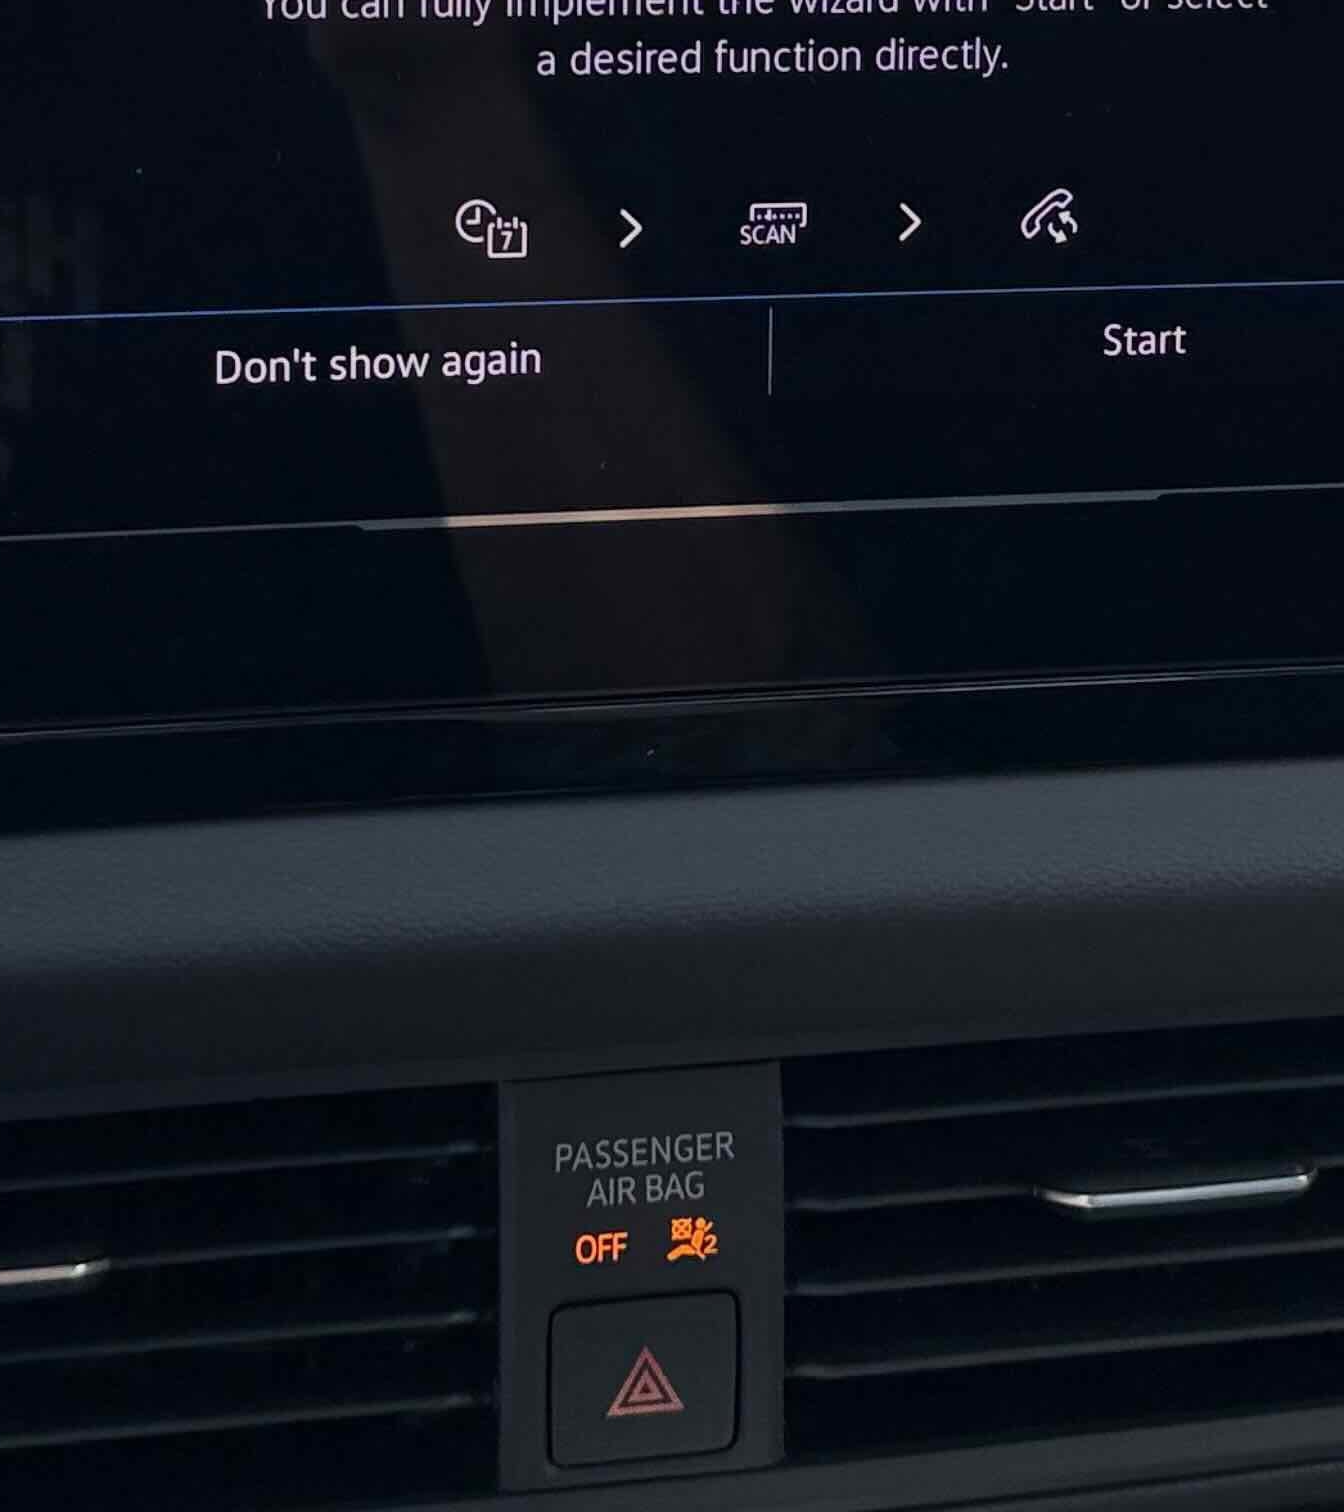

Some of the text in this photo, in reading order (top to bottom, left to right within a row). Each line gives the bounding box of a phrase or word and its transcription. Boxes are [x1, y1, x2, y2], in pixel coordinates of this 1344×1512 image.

[538, 38, 1008, 78] a desired function directly.
[742, 225, 796, 246] SCAN
[1105, 325, 1187, 357] Start
[218, 343, 541, 385] Don't show again
[555, 1131, 736, 1172] PASSENGER
[587, 1172, 705, 1208] AIR BAG
[577, 1233, 628, 1264] OFF
